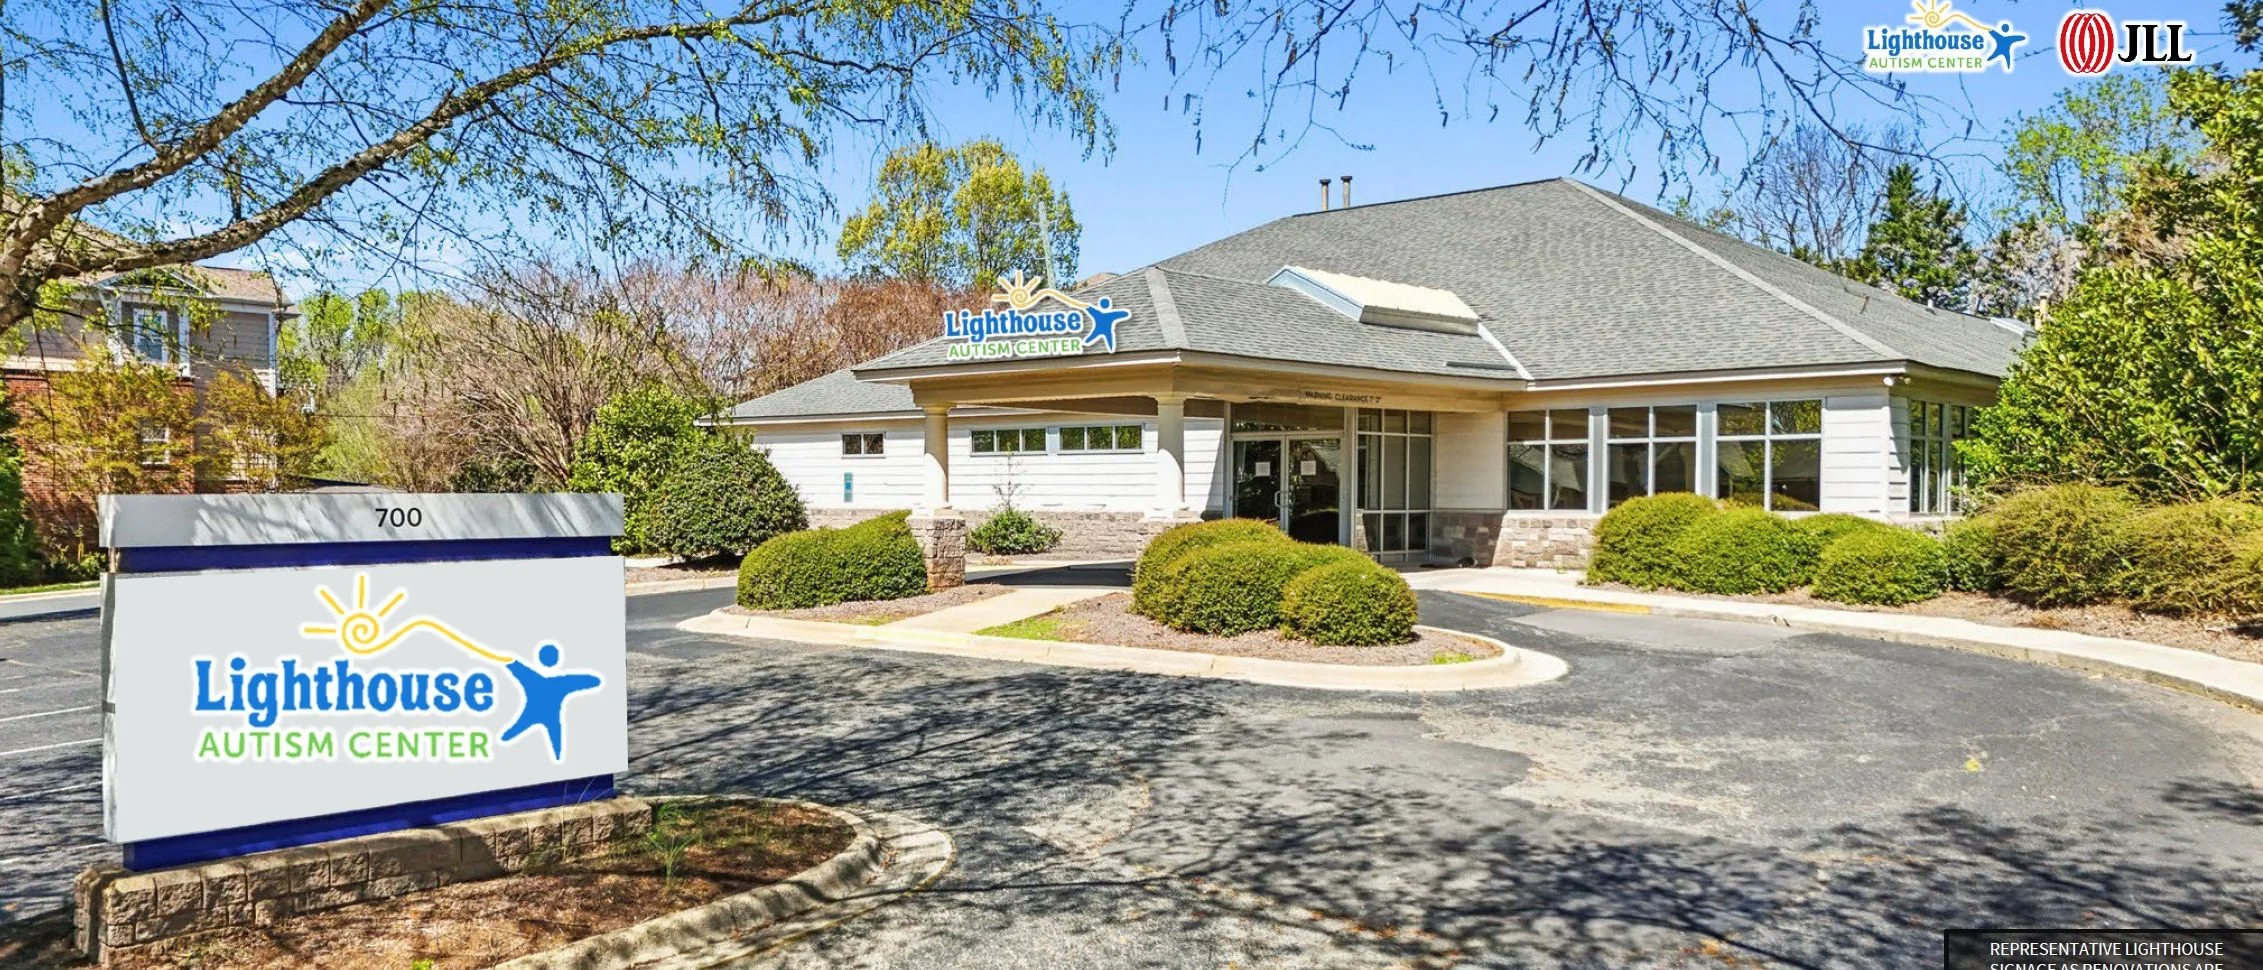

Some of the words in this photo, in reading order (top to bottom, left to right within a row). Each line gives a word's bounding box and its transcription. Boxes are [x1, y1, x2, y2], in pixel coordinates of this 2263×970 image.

[945, 310, 1081, 343] Lighthouse
[949, 342, 1010, 358] AUTISM
[1016, 338, 1081, 355] CENTER
[1334, 392, 1368, 403] CLEARANCE
[375, 507, 422, 528] 700
[195, 656, 493, 728] Lighthouse
[198, 730, 334, 760] AUTISM
[348, 730, 489, 759] CENTER
